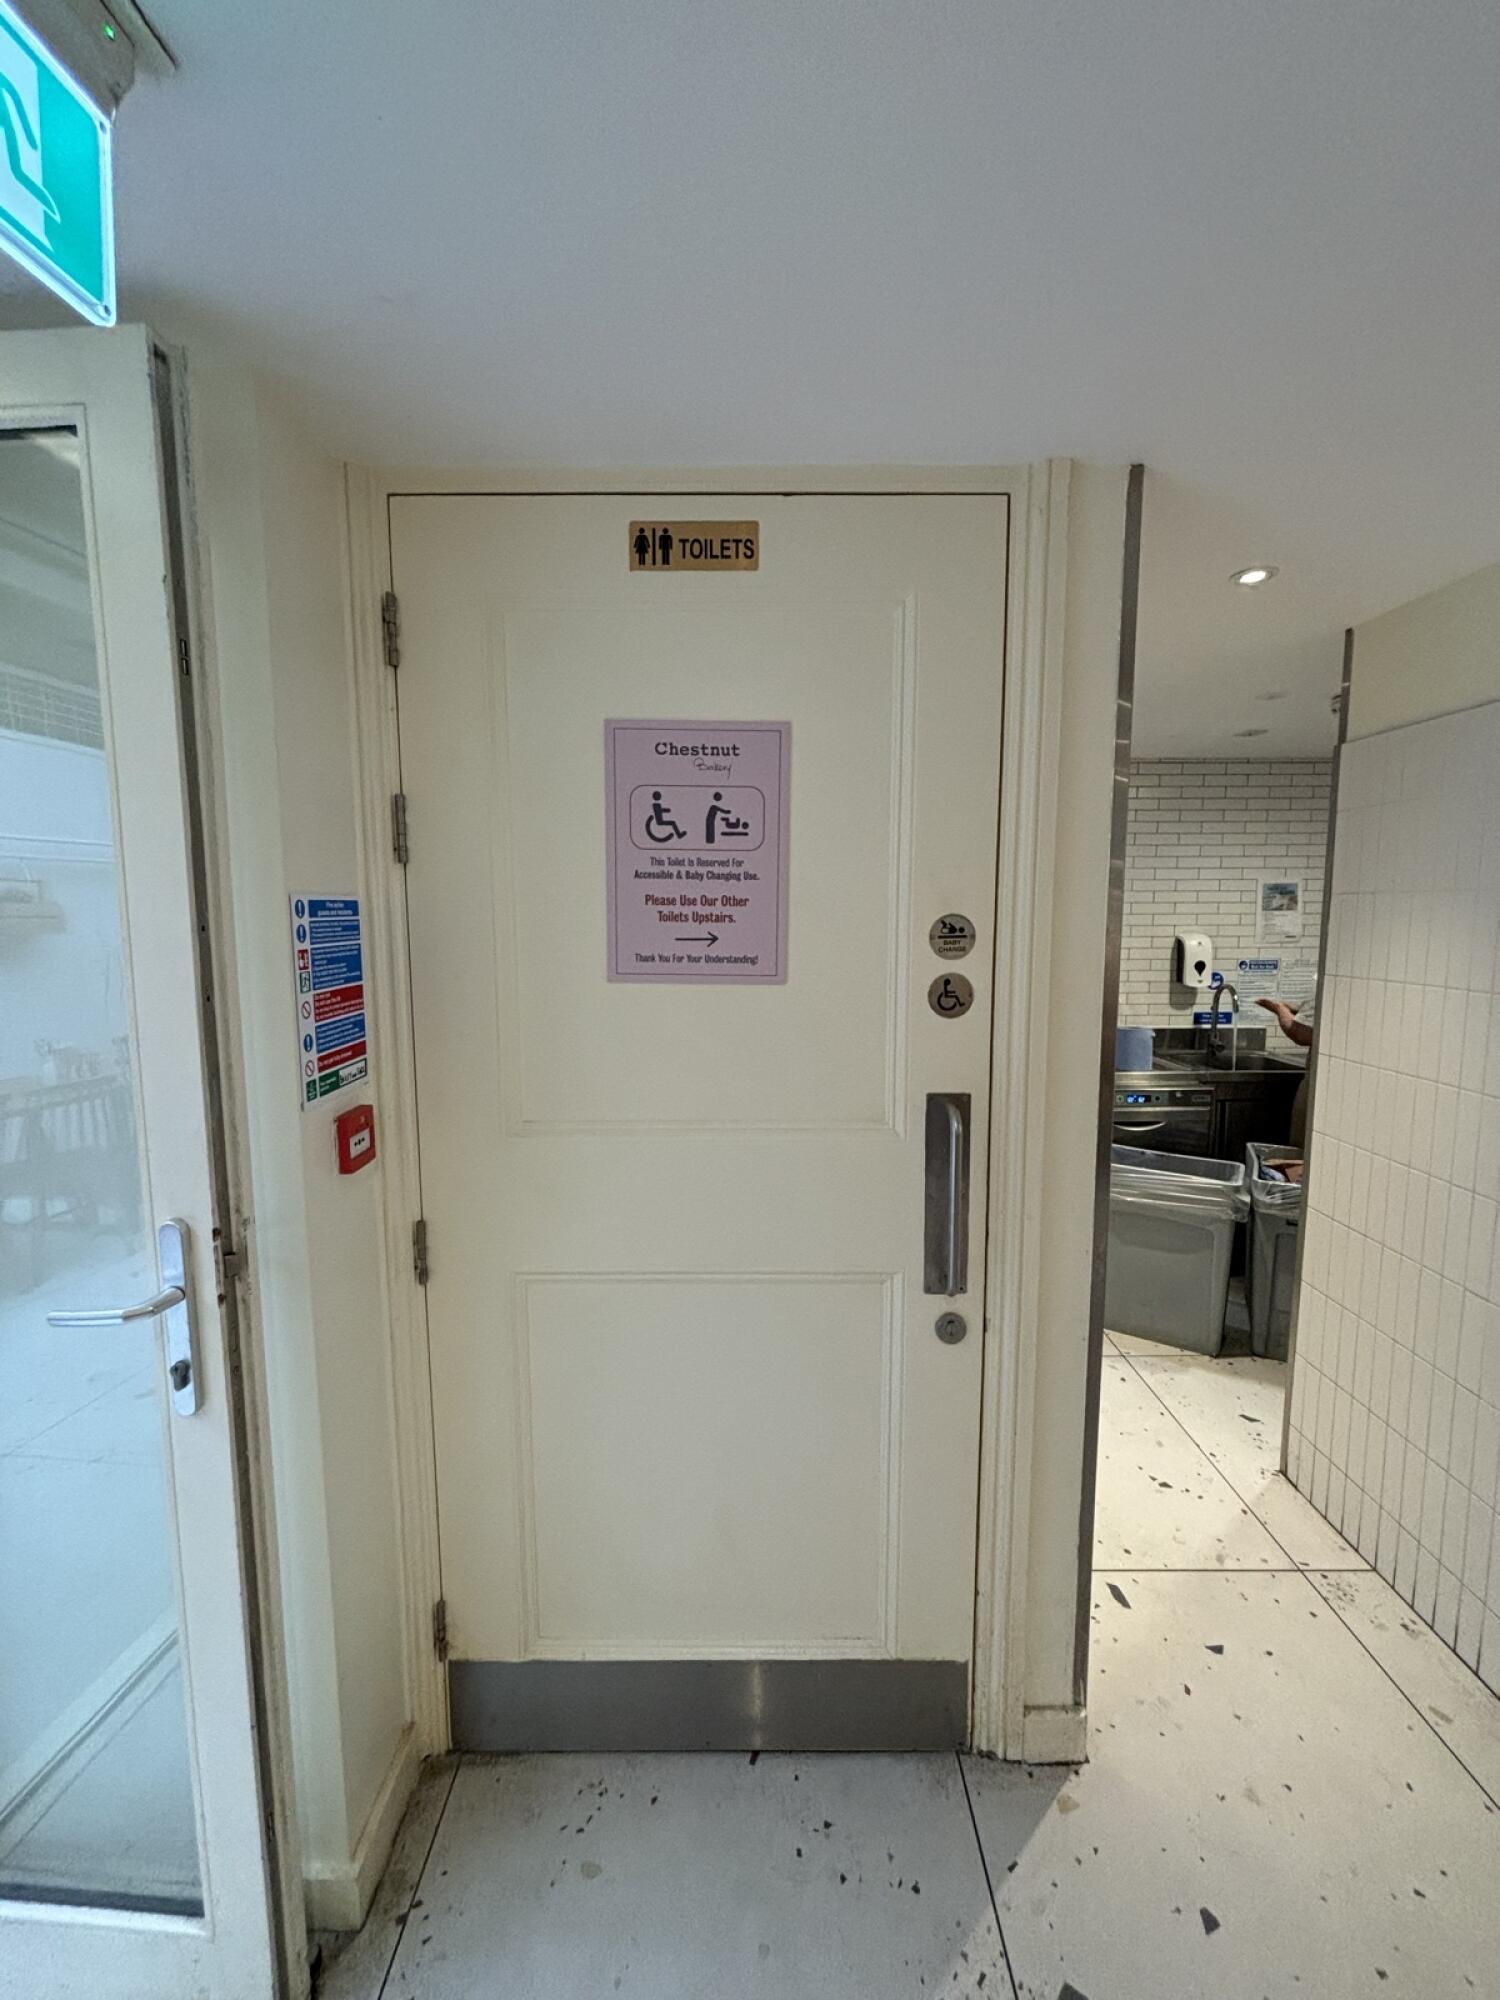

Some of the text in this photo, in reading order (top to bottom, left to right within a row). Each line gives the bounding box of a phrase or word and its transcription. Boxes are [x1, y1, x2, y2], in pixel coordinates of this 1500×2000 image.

[678, 538, 755, 560] TOILETS
[655, 742, 740, 757] Chestnut
[694, 757, 732, 779] Bakery
[650, 857, 665, 866] This
[667, 857, 686, 867] Toilet
[696, 857, 731, 868] Reserved
[634, 869, 760, 882] Accessible & Baby Changing Use.
[645, 894, 749, 907] Please Use Our Other
[657, 911, 736, 925] Toilets Upstairs.
[635, 953, 656, 963] Thank
[658, 953, 671, 963] You
[686, 954, 703, 964] Your
